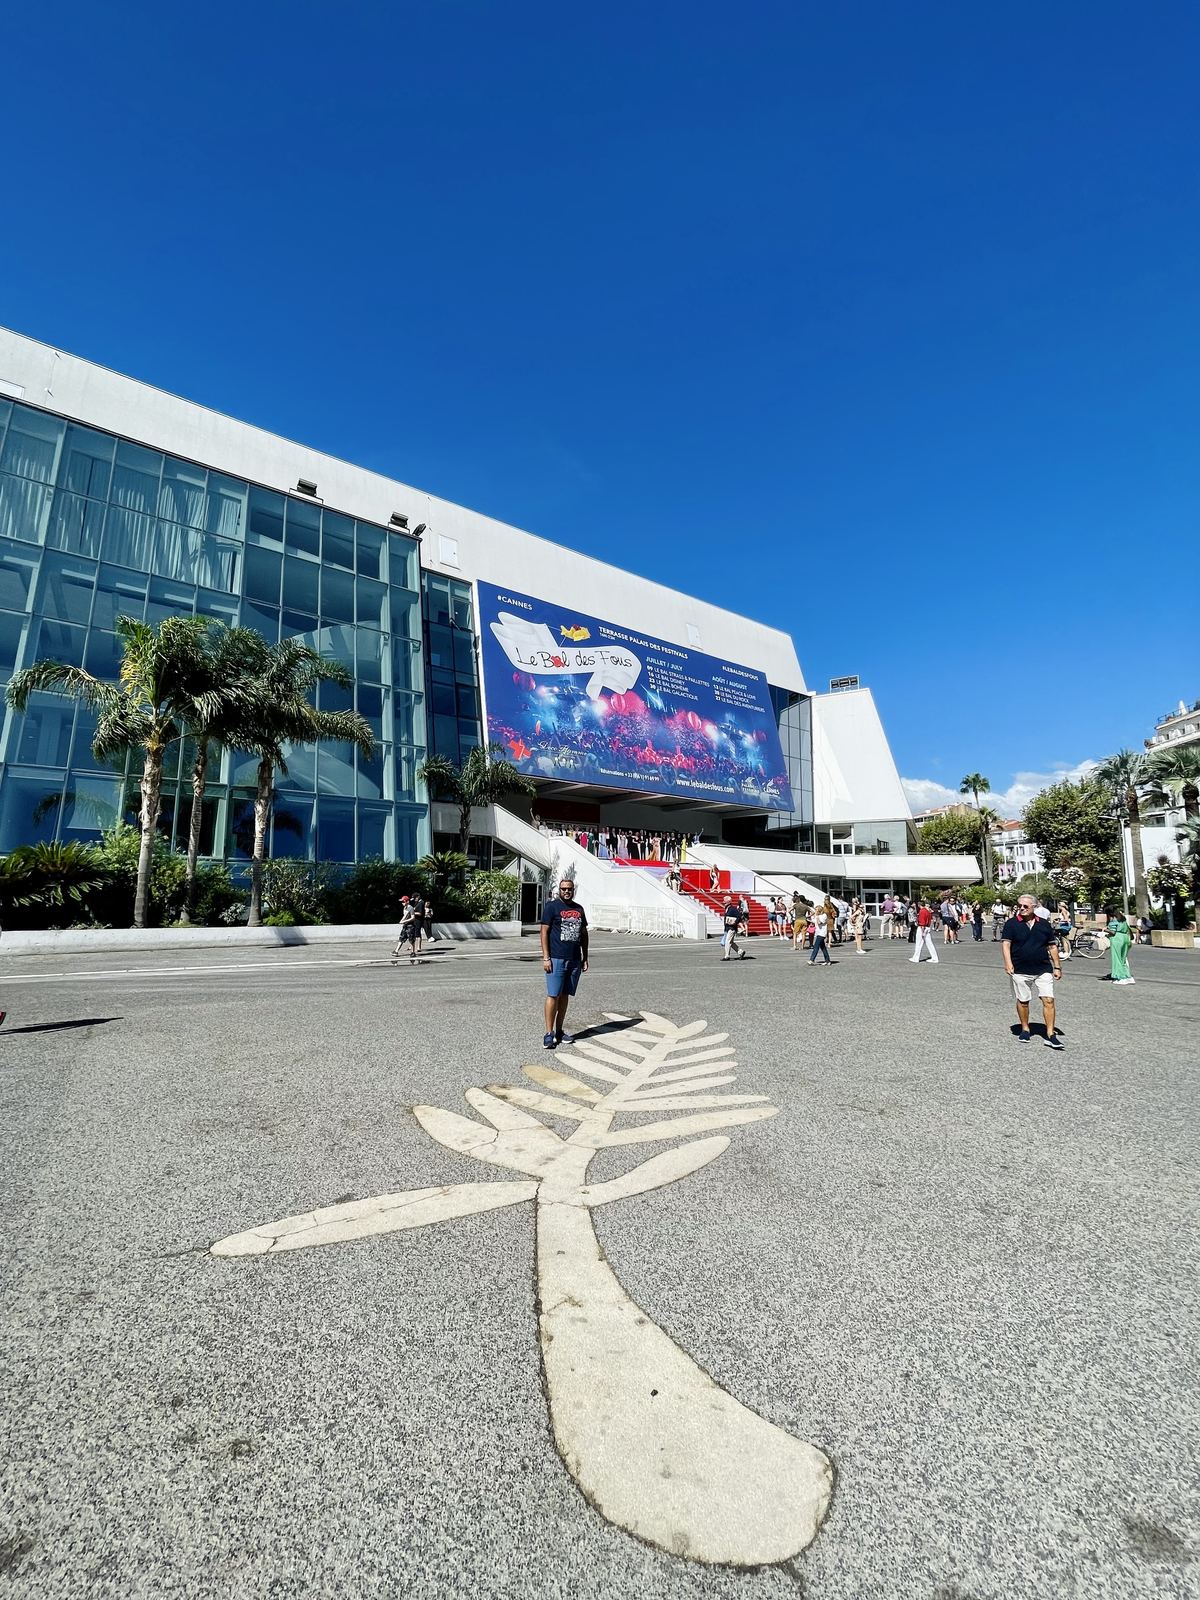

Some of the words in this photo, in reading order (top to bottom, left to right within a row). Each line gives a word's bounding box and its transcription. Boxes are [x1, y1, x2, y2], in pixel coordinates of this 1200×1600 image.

[497, 595, 532, 610] #CANNES
[599, 626, 628, 640] TERRASSE
[630, 636, 648, 647] PALAIS
[662, 647, 688, 659] FESTIVALS
[515, 648, 537, 666] Le
[538, 651, 570, 668] Bal
[576, 650, 595, 666] des
[595, 650, 633, 667] Fous
[646, 657, 666, 667] JUILLET
[729, 681, 747, 690] AUGUST
[672, 689, 698, 700] GALACTIQUE
[676, 778, 735, 793] www.lebaldesfous.com
